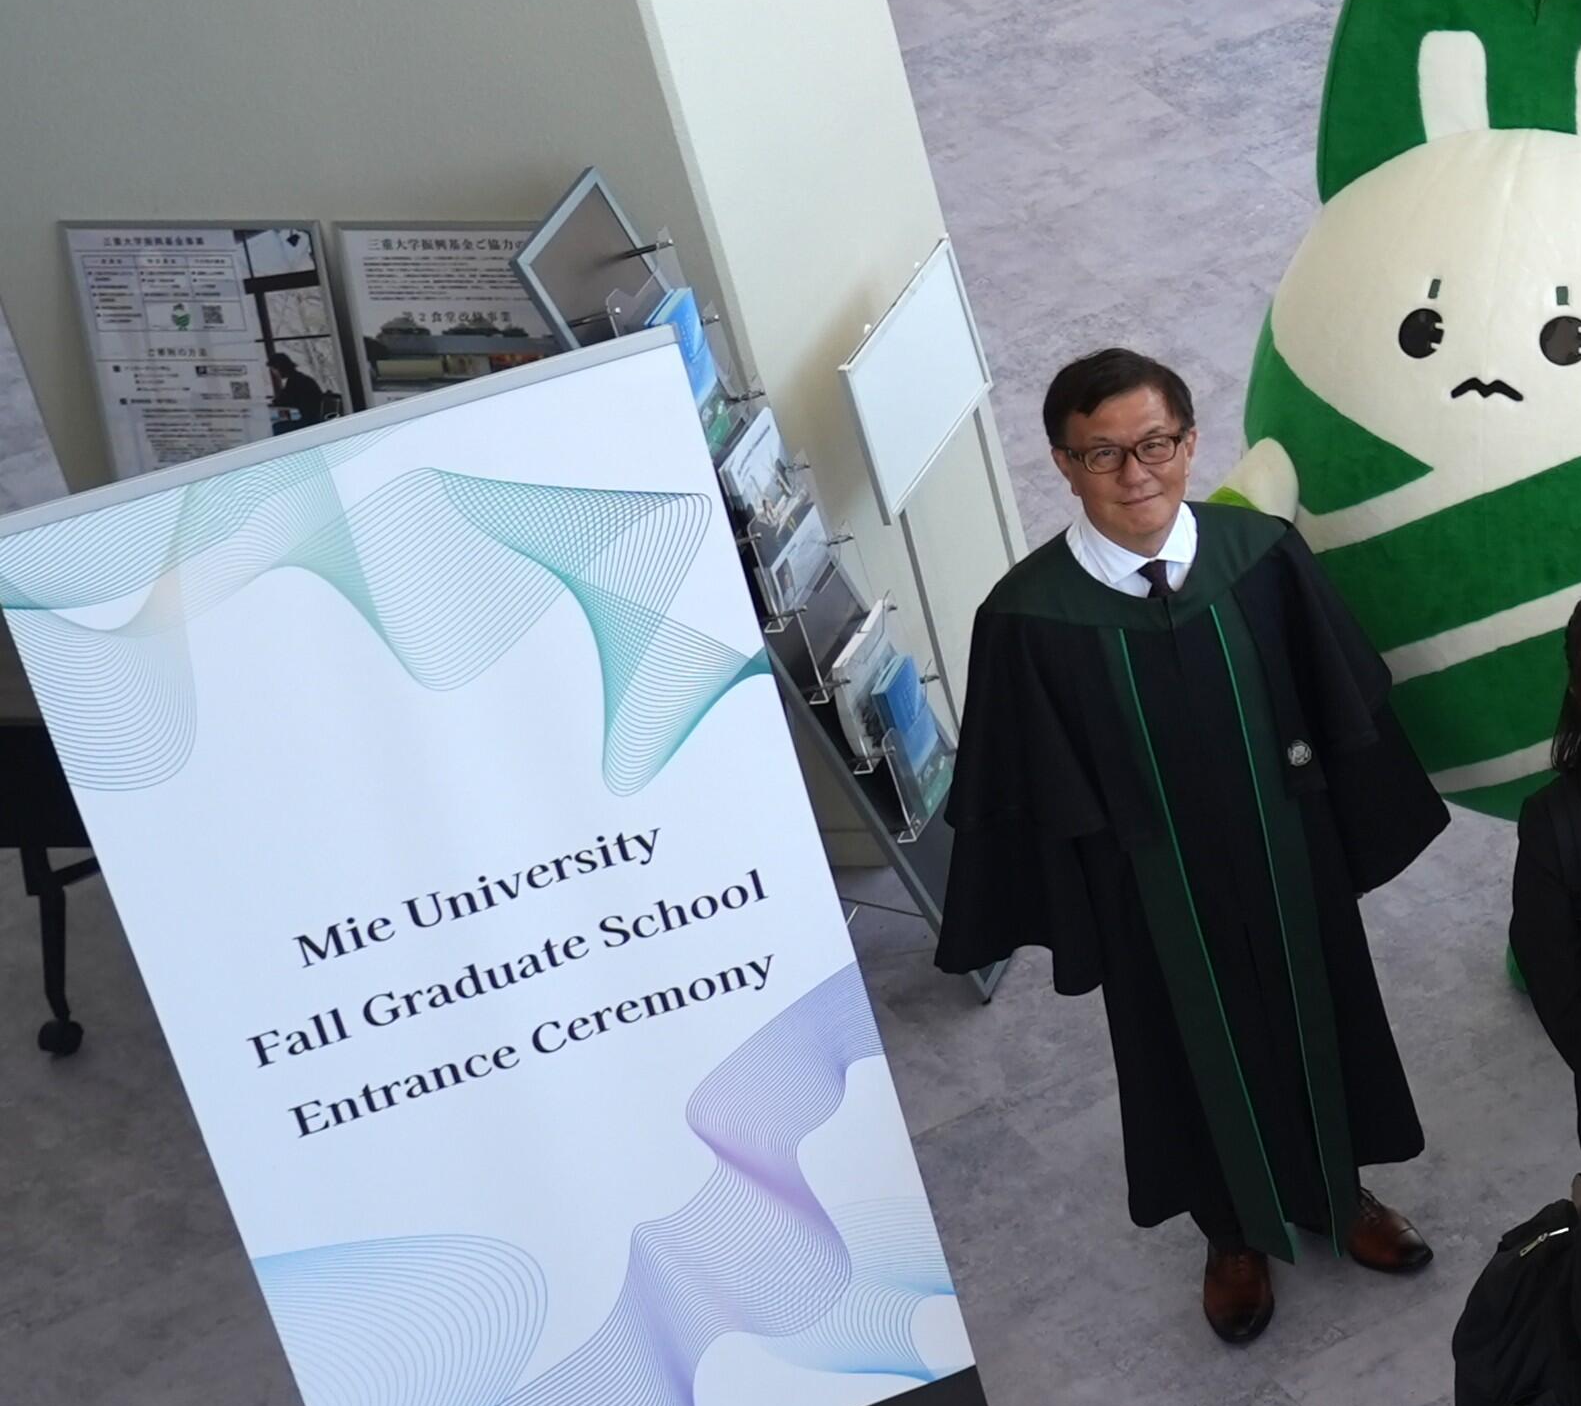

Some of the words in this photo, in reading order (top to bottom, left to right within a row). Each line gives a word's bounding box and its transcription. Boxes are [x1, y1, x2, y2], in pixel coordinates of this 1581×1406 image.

[246, 1007, 353, 1068] Fall
[362, 933, 591, 1028] Graduate
[598, 868, 769, 948] School
[293, 916, 396, 968] Mie
[402, 827, 662, 929] University
[288, 1045, 521, 1139] Entrance
[531, 953, 776, 1055] Ceremony
